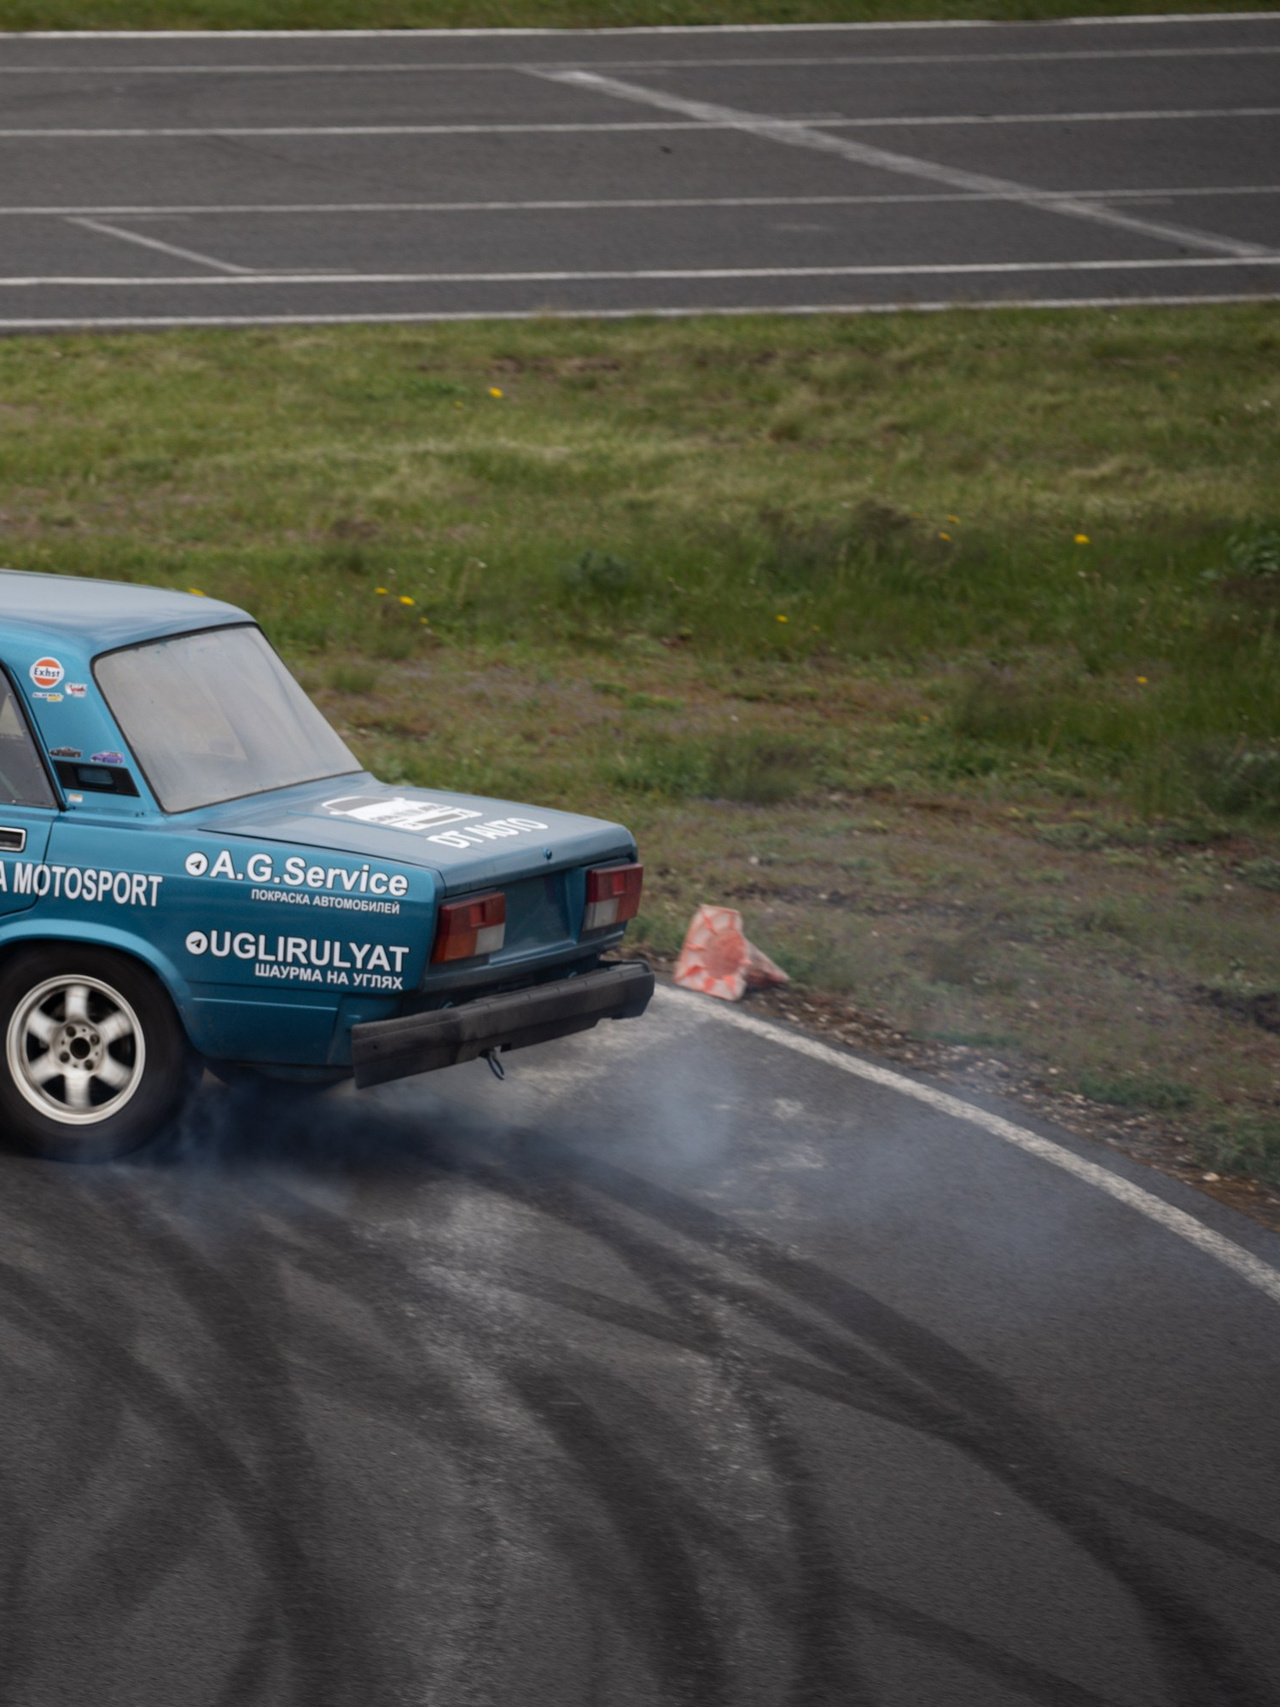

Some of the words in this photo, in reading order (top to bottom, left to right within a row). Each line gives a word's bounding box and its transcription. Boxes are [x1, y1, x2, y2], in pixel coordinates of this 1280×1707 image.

[34, 667, 60, 677] Exhst
[426, 830, 484, 849] DT
[463, 817, 549, 840] AUTO
[13, 861, 163, 907] MOTOSPORT
[209, 850, 409, 897] A.G.Service
[251, 888, 310, 905] ПОКРАСКА
[312, 896, 401, 915] АВТОМОБИЛЕЙ
[210, 930, 410, 973] UGLIRULYAT
[254, 963, 322, 983] ШАУРМА
[326, 970, 349, 985] НА
[352, 973, 403, 990] УГЛЯХ
